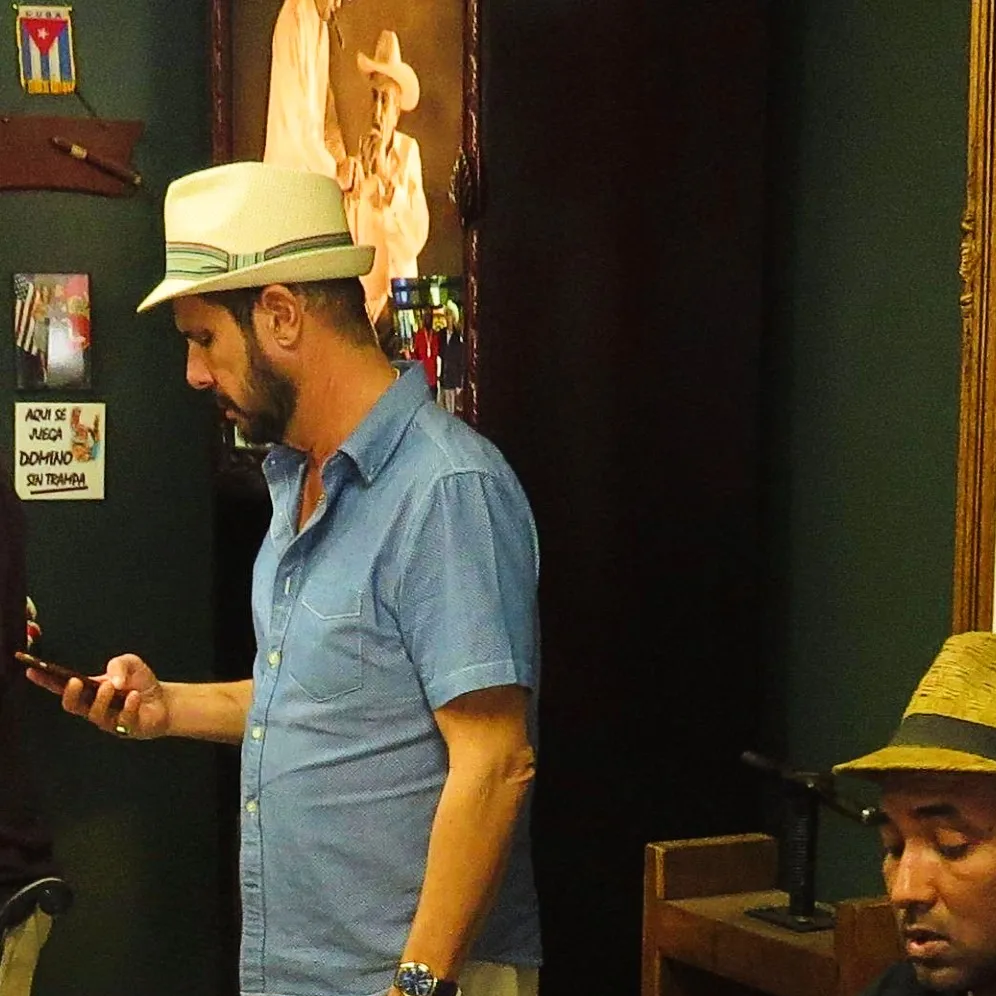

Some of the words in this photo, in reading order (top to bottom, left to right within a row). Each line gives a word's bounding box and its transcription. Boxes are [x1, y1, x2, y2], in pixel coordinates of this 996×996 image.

[25, 408, 51, 422] AQUI
[54, 408, 67, 421] SE
[29, 427, 63, 441] JUEGA
[19, 450, 73, 466] DOMINO
[26, 473, 43, 486] SIN
[45, 472, 86, 486] TRAMPA
